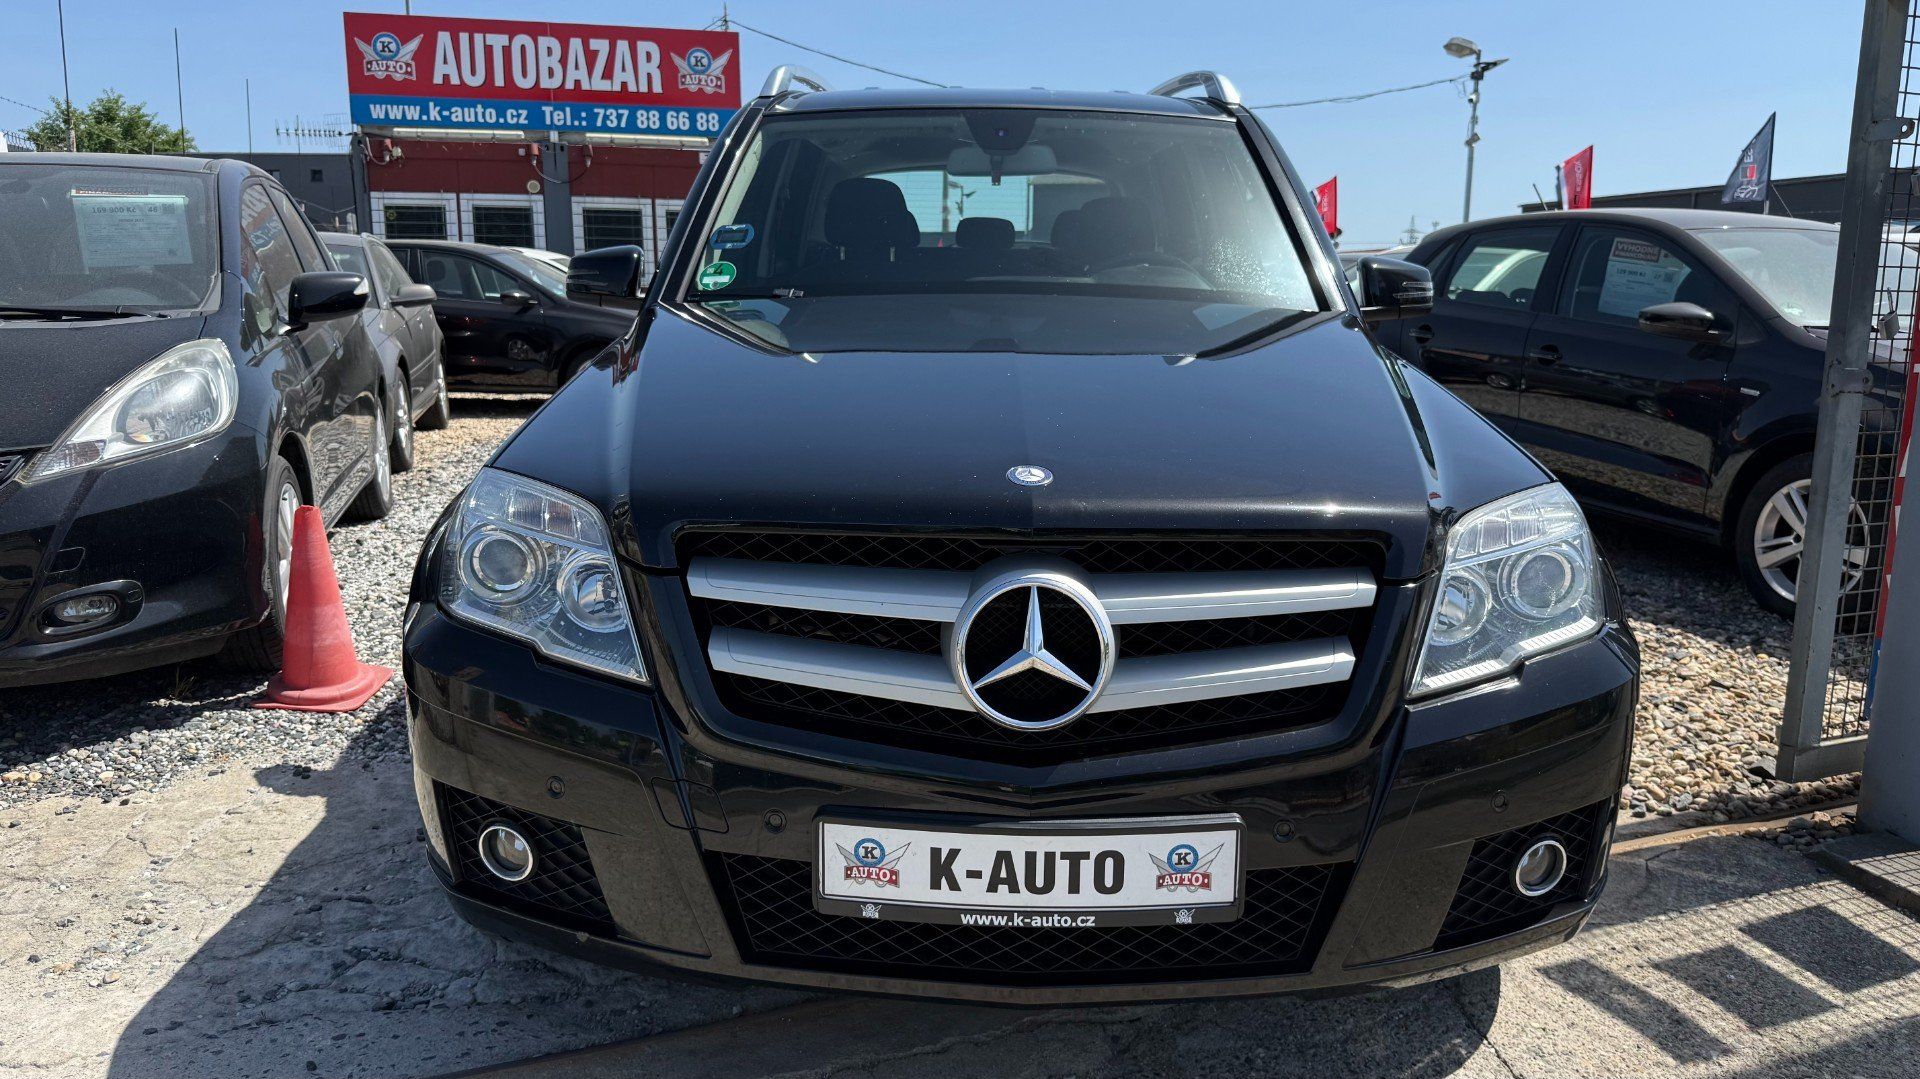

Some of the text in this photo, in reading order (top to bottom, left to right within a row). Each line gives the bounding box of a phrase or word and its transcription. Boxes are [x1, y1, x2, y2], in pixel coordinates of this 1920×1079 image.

[379, 41, 394, 53] K
[371, 60, 406, 73] AUTO
[433, 31, 663, 94] AUTOBAZAR
[692, 55, 706, 67] K
[369, 101, 719, 131] www.k-auto.cz Tel.: 737 88 66 88
[862, 846, 878, 859] K
[1175, 852, 1191, 866] K
[850, 867, 891, 881] AUTO
[929, 846, 1126, 896] K-AUTO
[1163, 873, 1203, 886] AUTO
[960, 911, 1096, 928] www.k-auto.cz
